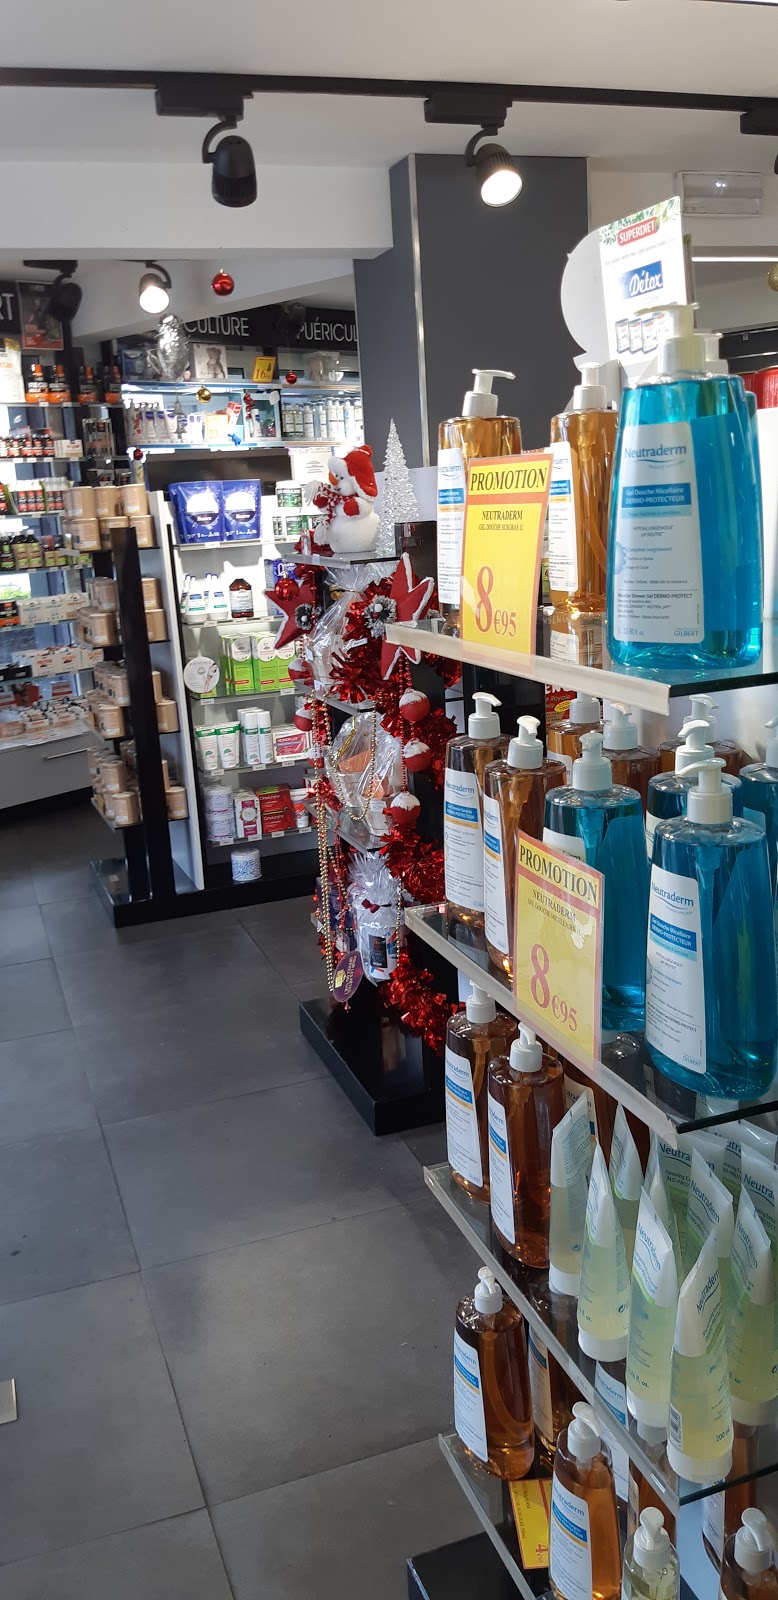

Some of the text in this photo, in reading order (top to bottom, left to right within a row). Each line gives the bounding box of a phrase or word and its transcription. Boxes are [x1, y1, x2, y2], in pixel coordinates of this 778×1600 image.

[619, 220, 656, 244] SUPERDIET
[629, 270, 664, 297] Détox
[624, 445, 687, 459] Neutraderm
[470, 467, 548, 492] PROMOTION
[655, 487, 684, 495] Micellaire
[625, 495, 685, 504] DERMO-PROTECTEUR
[482, 510, 524, 521] NEUTRADERM
[519, 844, 598, 904] PROMOTION
[532, 889, 576, 922] NEUTRADERM
[651, 881, 694, 907] Neutraderm
[682, 1055, 701, 1068] GILBERT
[690, 1179, 720, 1224] Neutraderm
[637, 1222, 661, 1271] Neutraderm
[716, 1432, 725, 1442] 200
